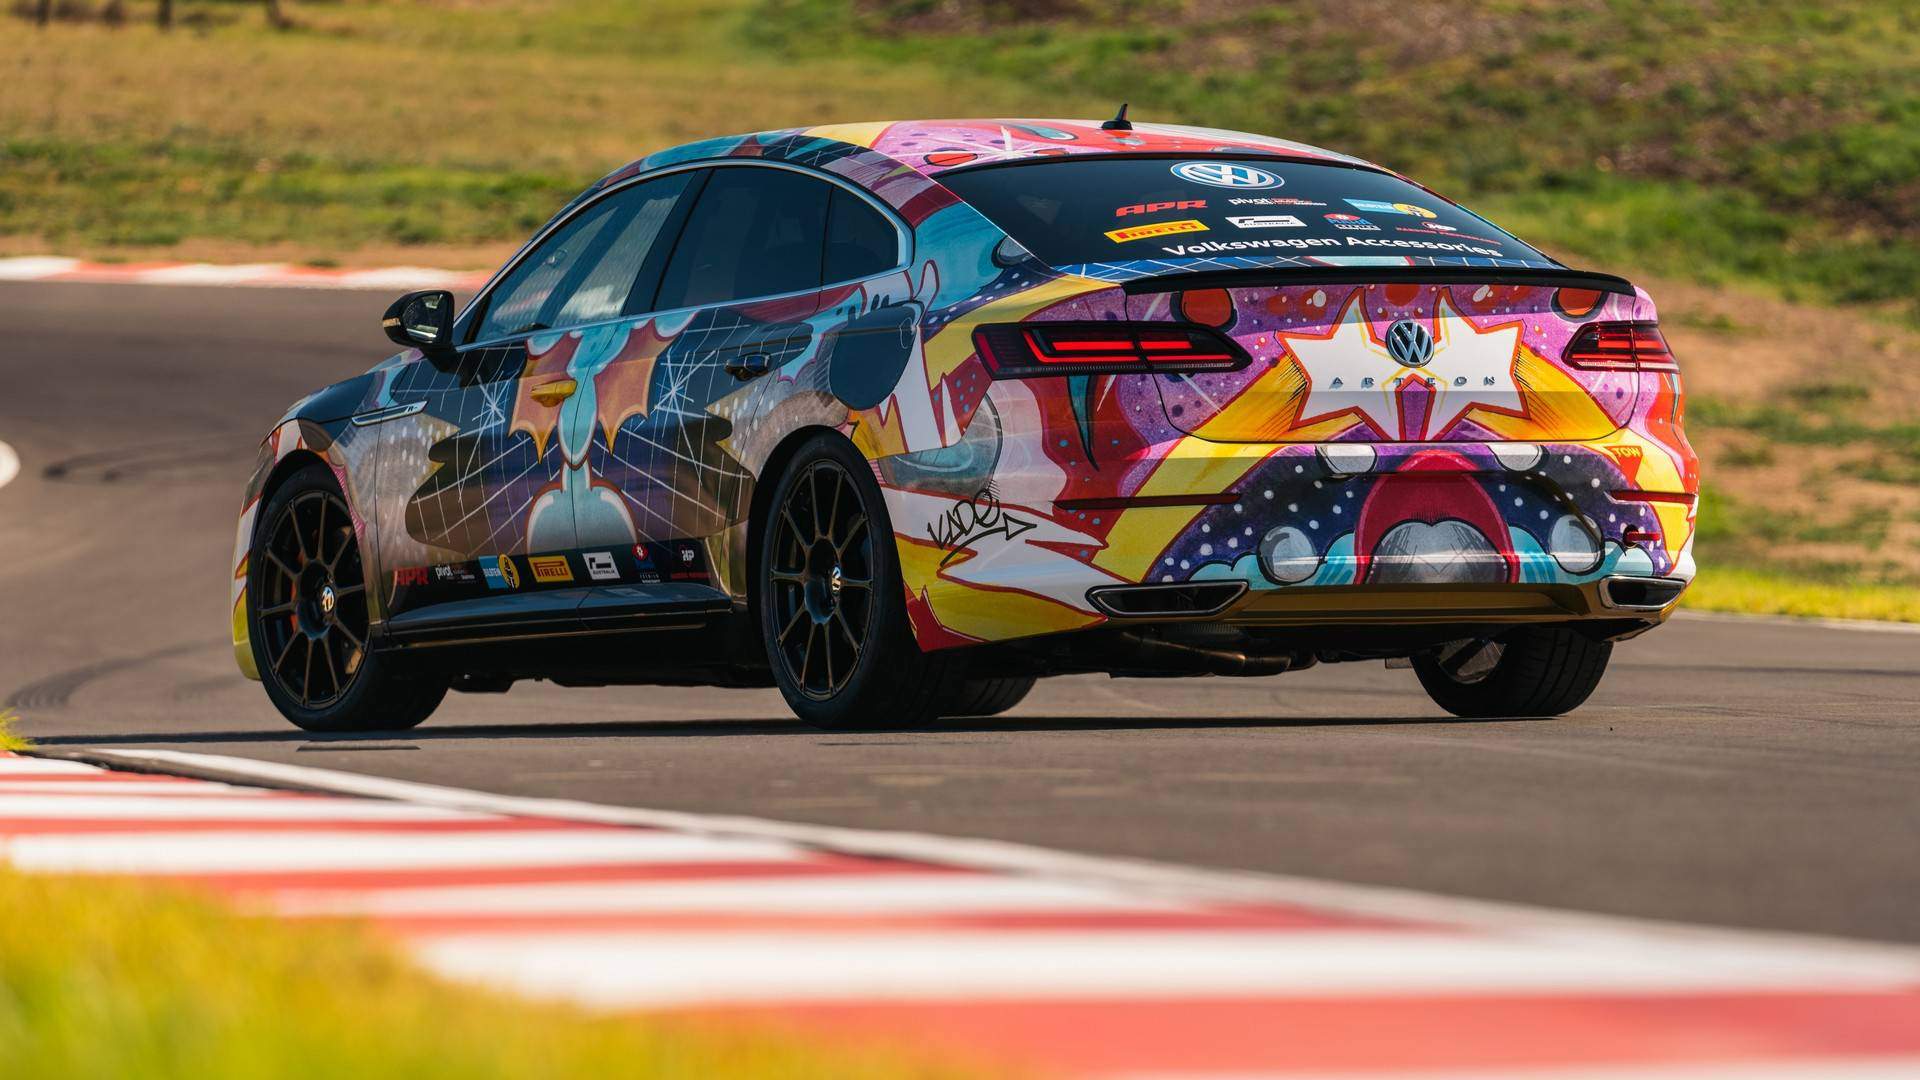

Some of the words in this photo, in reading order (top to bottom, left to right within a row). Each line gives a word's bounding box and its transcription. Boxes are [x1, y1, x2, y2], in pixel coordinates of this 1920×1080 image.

[1116, 200, 1208, 217] APR
[1162, 236, 1342, 256] Volkswagen
[1346, 236, 1504, 257] Accessories
[1330, 376, 1496, 387] ARTEON
[1611, 447, 1641, 458] TOW
[396, 567, 429, 586] APR
[435, 563, 454, 580] pivot
[533, 560, 569, 577] PIRELLI
